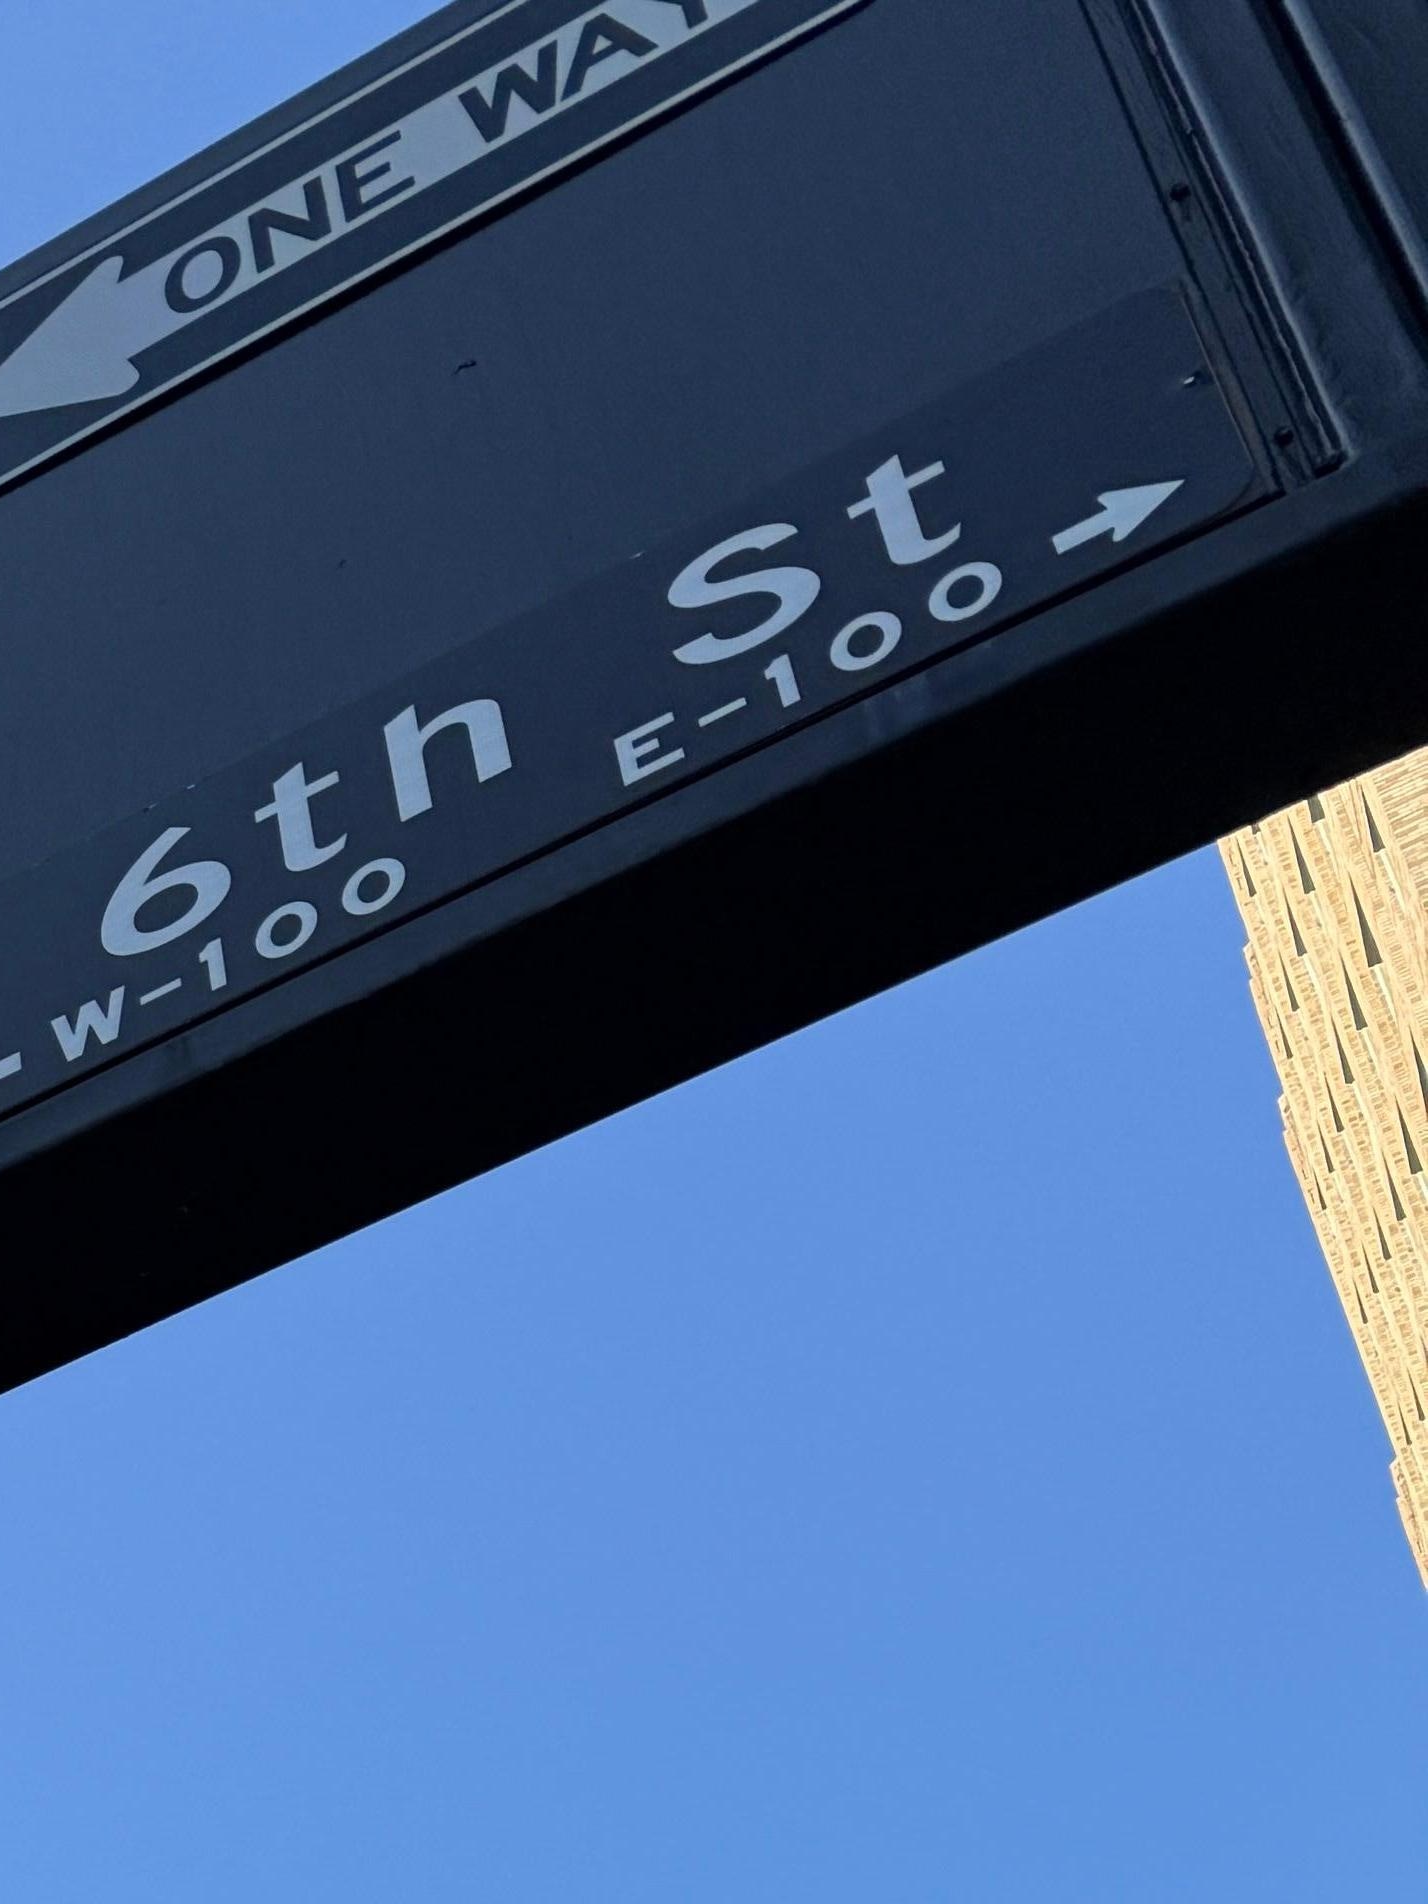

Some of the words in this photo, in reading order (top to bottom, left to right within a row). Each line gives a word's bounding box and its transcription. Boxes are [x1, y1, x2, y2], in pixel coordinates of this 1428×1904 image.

[162, 130, 416, 316] ONE
[50, 857, 406, 1062] W-100
[614, 562, 1003, 788] E-100
[98, 696, 513, 958] 6th
[666, 454, 967, 669] St
